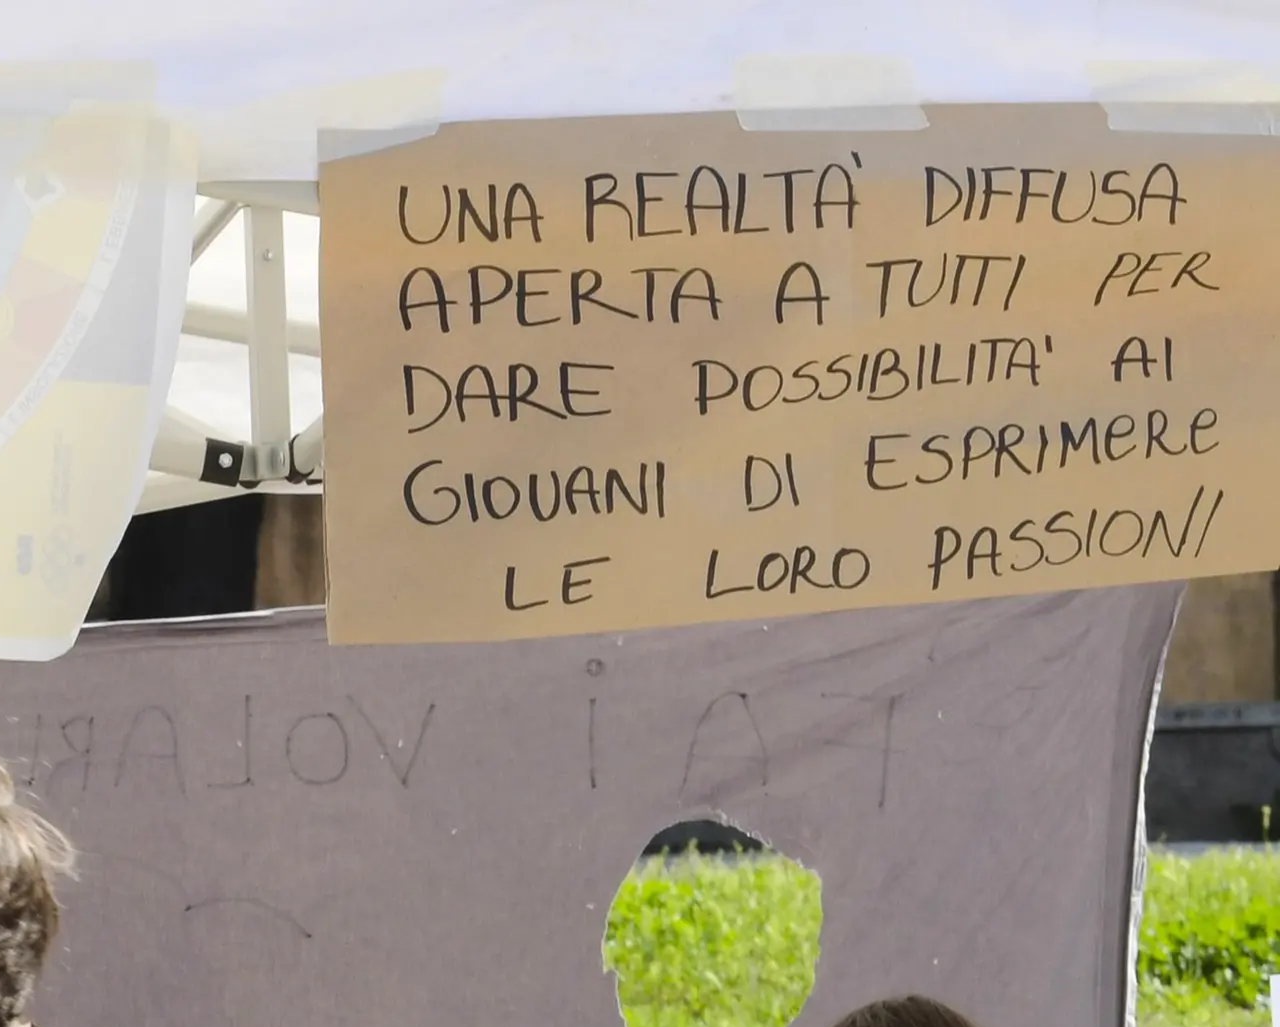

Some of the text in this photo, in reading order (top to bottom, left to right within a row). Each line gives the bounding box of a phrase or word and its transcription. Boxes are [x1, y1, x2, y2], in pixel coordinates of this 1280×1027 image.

[398, 183, 544, 245] UNA
[925, 162, 1188, 228] DIFFUSA
[399, 249, 1221, 334] APERTA A TUTTI PER
[403, 361, 614, 434] DARE
[1110, 336, 1174, 383] AI
[744, 454, 801, 512] DI
[504, 487, 1225, 611] LE LORO PASSIONI
